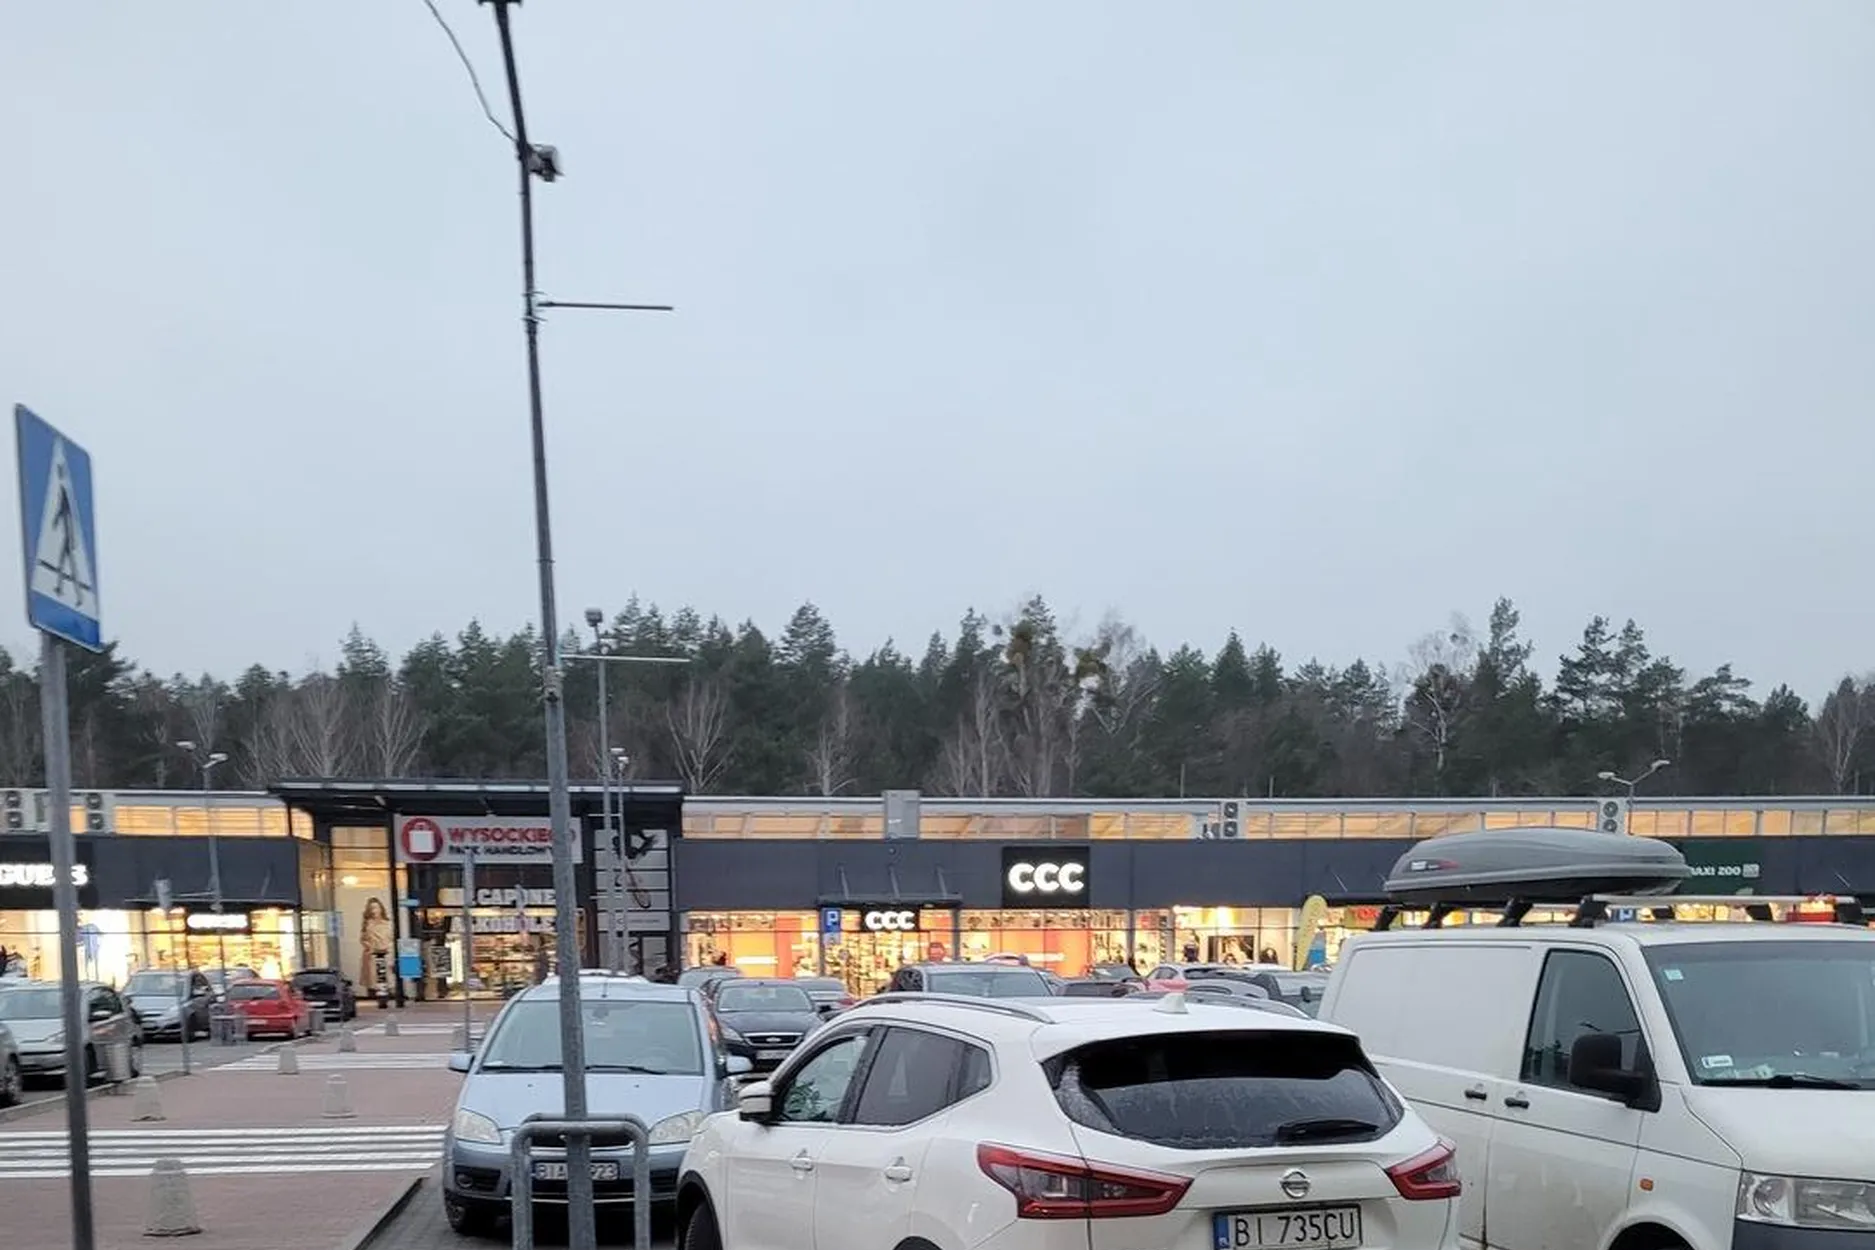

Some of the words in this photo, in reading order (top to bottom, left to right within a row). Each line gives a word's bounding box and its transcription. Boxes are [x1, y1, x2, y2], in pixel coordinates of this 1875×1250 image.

[0, 863, 89, 888] GUES
[1008, 862, 1085, 892] CCC
[1717, 866, 1741, 877] ZOO
[865, 910, 915, 931] CCC
[1235, 1215, 1263, 1247] BI
[1278, 1211, 1355, 1244] 735CU
